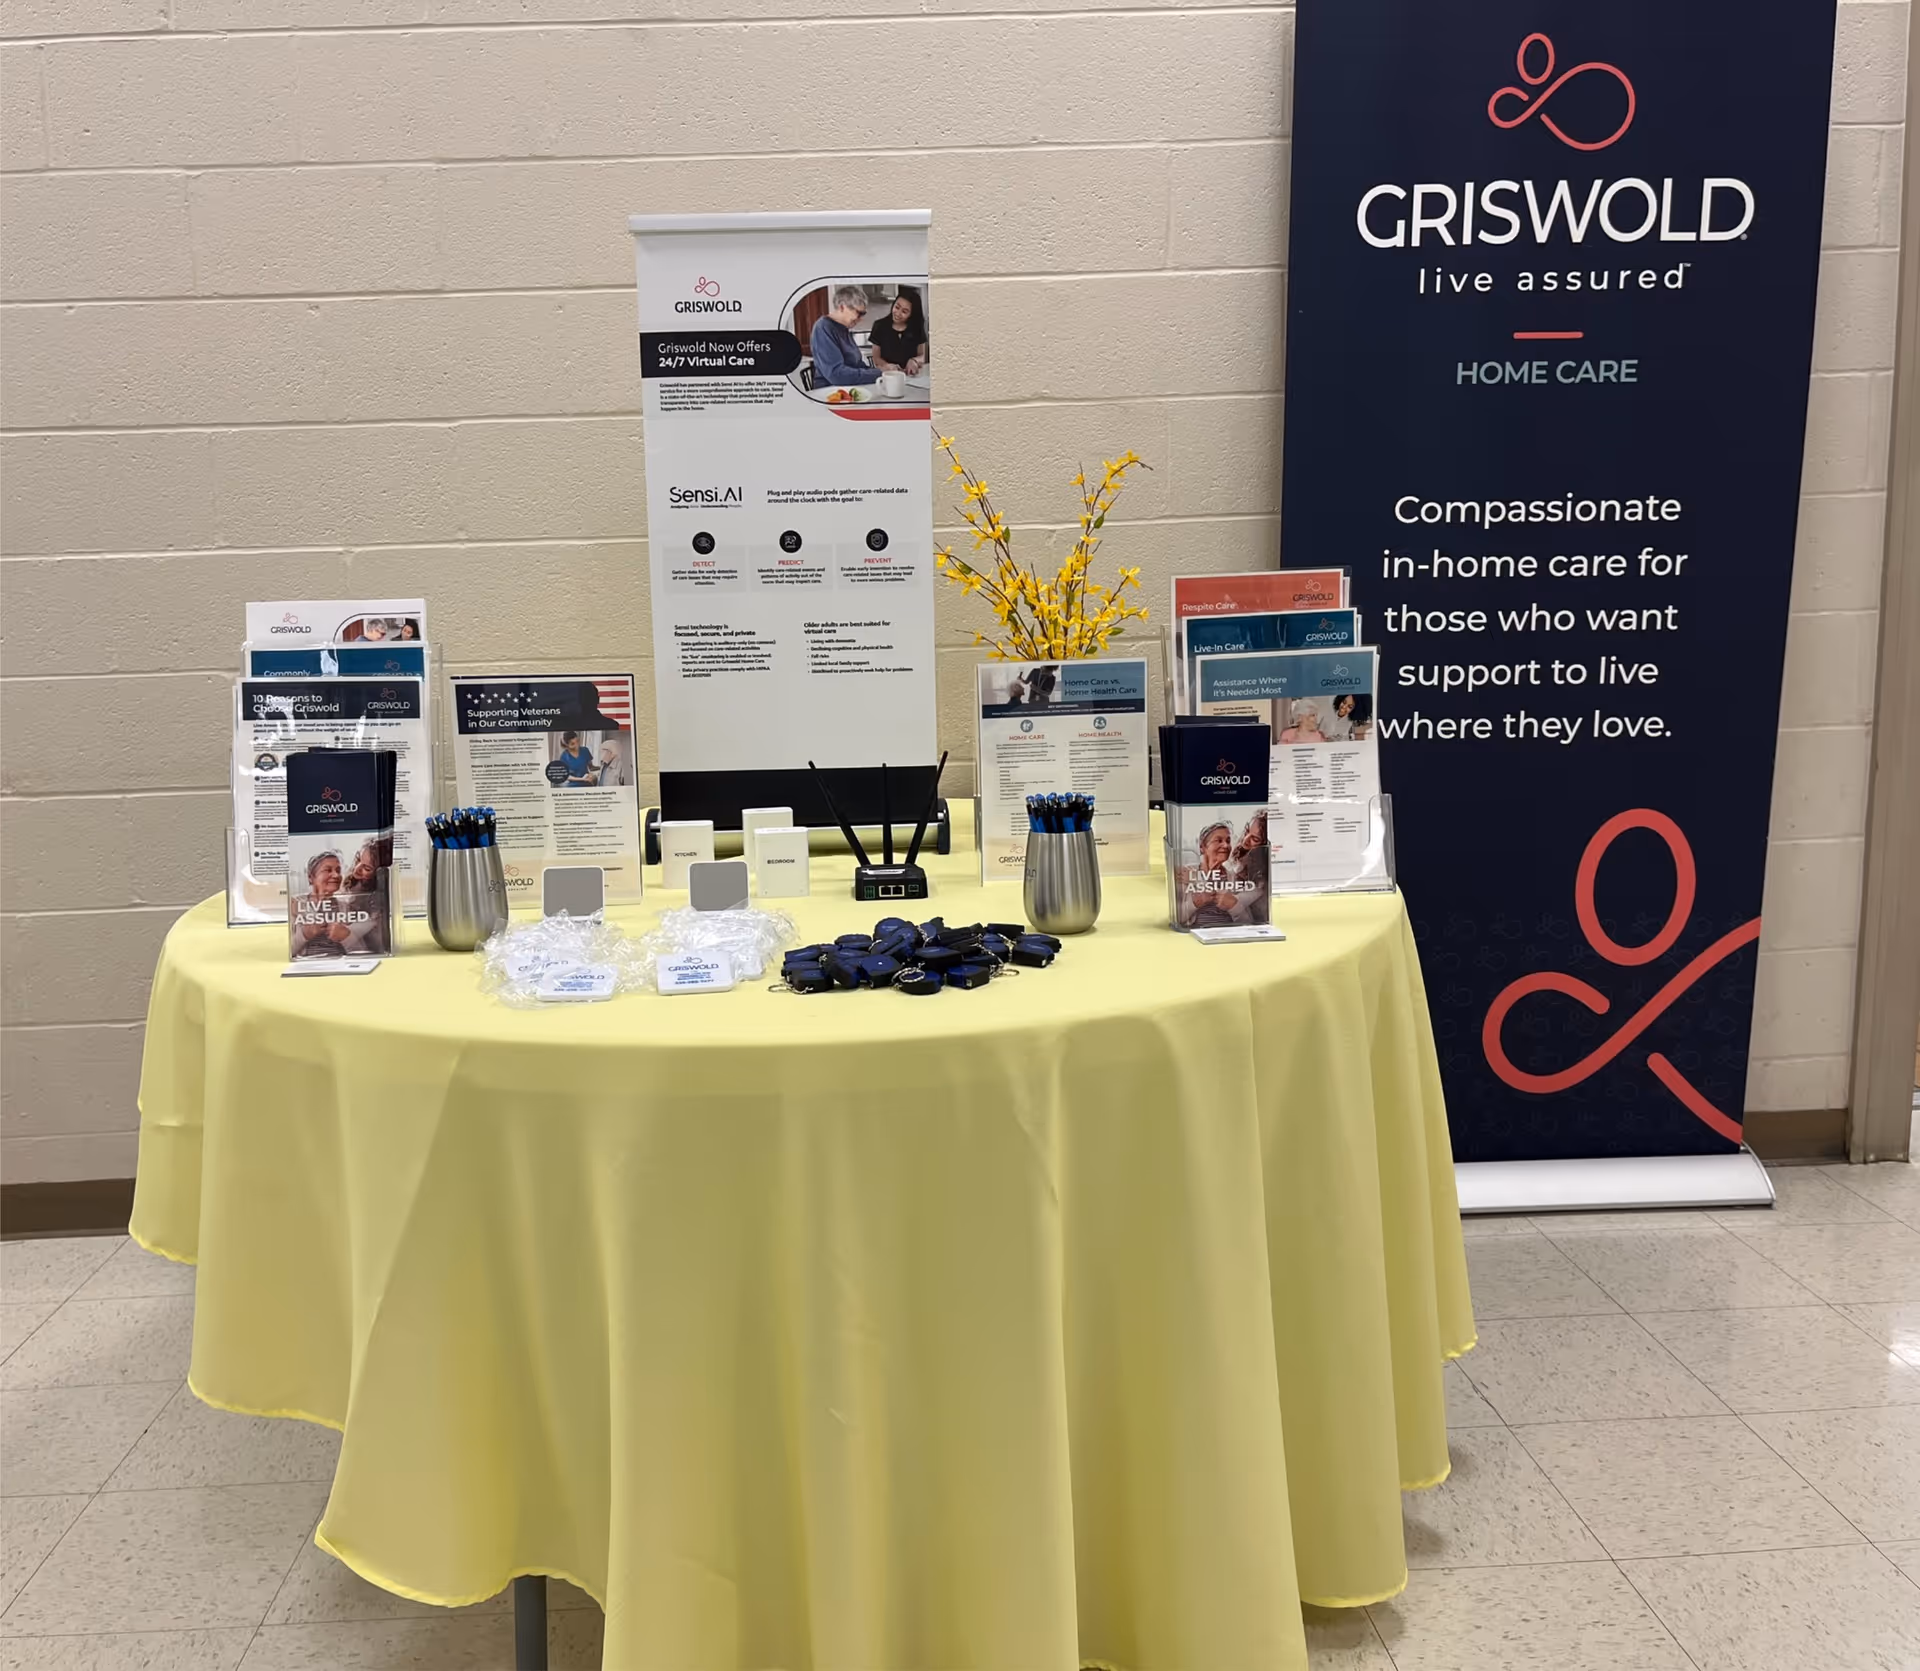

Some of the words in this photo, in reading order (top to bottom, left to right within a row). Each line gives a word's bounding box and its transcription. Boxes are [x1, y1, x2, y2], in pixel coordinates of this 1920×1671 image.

[1418, 268, 1493, 293] live
[674, 300, 742, 313] GRISWOLD
[658, 342, 706, 354] Griswold
[709, 342, 734, 353] Now
[737, 341, 771, 353] Offers
[659, 356, 685, 368] 24/7
[687, 355, 726, 367] Virtual
[729, 356, 755, 367] Care
[1457, 361, 1548, 384] HOME
[1556, 360, 1638, 383] CARE
[670, 487, 742, 503] Sensi.AI
[1394, 492, 1682, 530] Compassionate
[1382, 549, 1538, 578] in-home
[1548, 555, 1627, 577] care
[1637, 547, 1688, 576] for
[1292, 593, 1334, 601] GRISWOLD
[1182, 603, 1214, 612] Respite
[1216, 602, 1236, 610] Care
[1384, 604, 1487, 632] those
[1498, 603, 1575, 631] who
[1586, 605, 1679, 631] want
[271, 626, 311, 634] GRISWOLD
[1306, 632, 1348, 641] GRISWOLD
[1194, 644, 1223, 653] Live-In
[1224, 643, 1245, 651] Care
[1398, 660, 1540, 692] support
[1551, 660, 1587, 685] to
[1600, 656, 1659, 685] live
[1064, 679, 1089, 687] Home
[1090, 678, 1109, 686] Care
[1213, 677, 1257, 687] Assistance
[1259, 676, 1287, 684] Where
[1321, 677, 1361, 687] GRISWOLD
[1064, 689, 1089, 697] Home
[1091, 688, 1117, 696] Health
[1118, 687, 1137, 695] Care
[1227, 687, 1260, 696] Needed
[1261, 687, 1282, 695] Most
[252, 695, 264, 703] 10
[265, 695, 310, 703] Reasons
[253, 704, 292, 713] Choose
[294, 703, 339, 712] Griswold
[367, 701, 410, 709] GRISWOLD
[467, 708, 519, 718] Supporting
[520, 708, 561, 716] Veterans
[468, 720, 477, 728] in
[478, 719, 496, 727] Our
[498, 718, 552, 728] Community
[1377, 711, 1493, 739] where
[1503, 711, 1583, 745] they
[1593, 710, 1672, 738] love.
[1200, 775, 1250, 785] GRISWOLD
[305, 803, 358, 814] GRISWOLD
[1189, 870, 1221, 882] LIVE
[1185, 880, 1256, 894] ASSURED
[297, 900, 332, 912] LIVE
[294, 911, 369, 925] ASSURED
[668, 963, 719, 971] GRISWOLD
